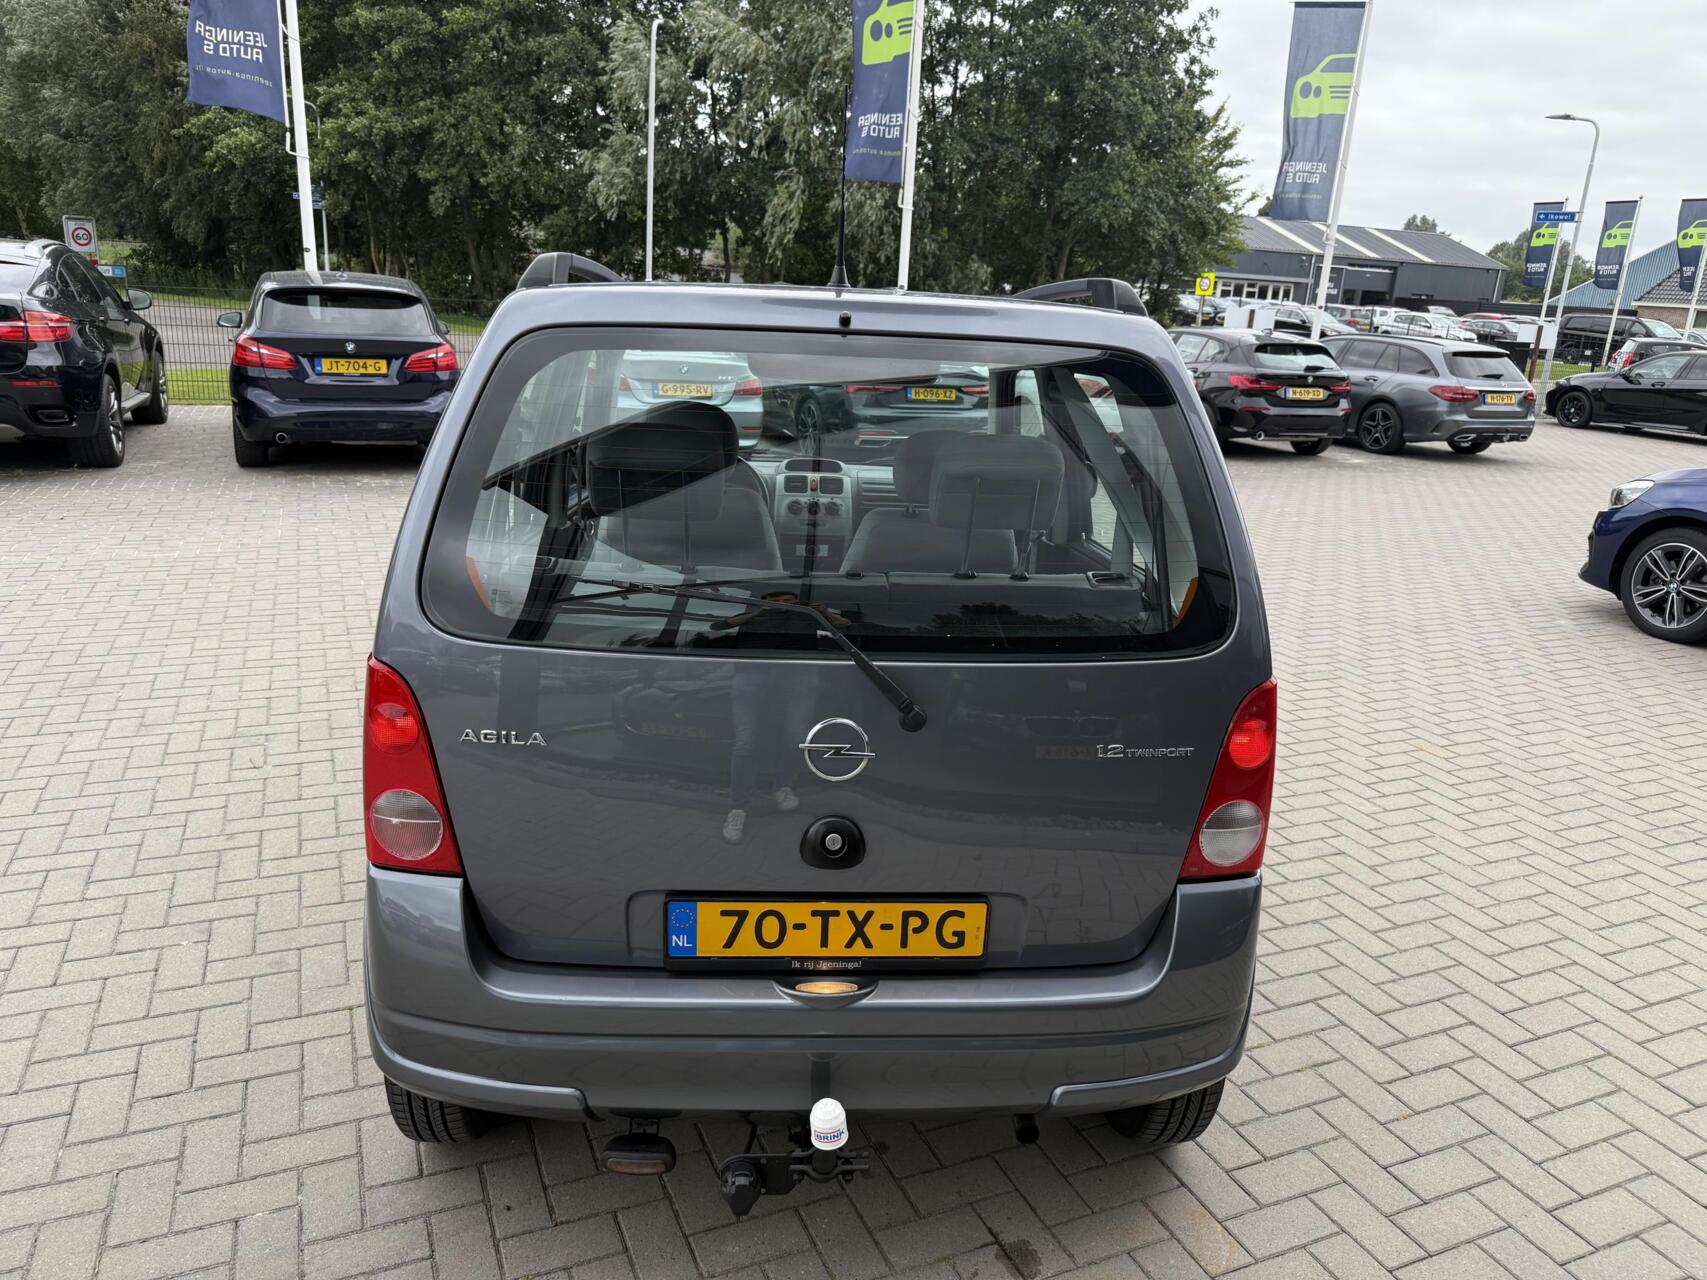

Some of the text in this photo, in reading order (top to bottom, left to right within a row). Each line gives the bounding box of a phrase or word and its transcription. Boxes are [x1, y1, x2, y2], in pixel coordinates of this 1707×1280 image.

[75, 233, 89, 241] 60
[327, 360, 382, 371] JT-704-G
[661, 384, 710, 396] G-995-RV
[914, 388, 954, 399] H-096-XZ
[460, 728, 548, 746] AGILA
[1126, 747, 1195, 758] TWINPORT
[719, 909, 967, 950] 70-TX-PG
[671, 934, 693, 948] NL
[791, 960, 862, 970] Ik rij Jeeninga!
[816, 1128, 845, 1142] BRINK
